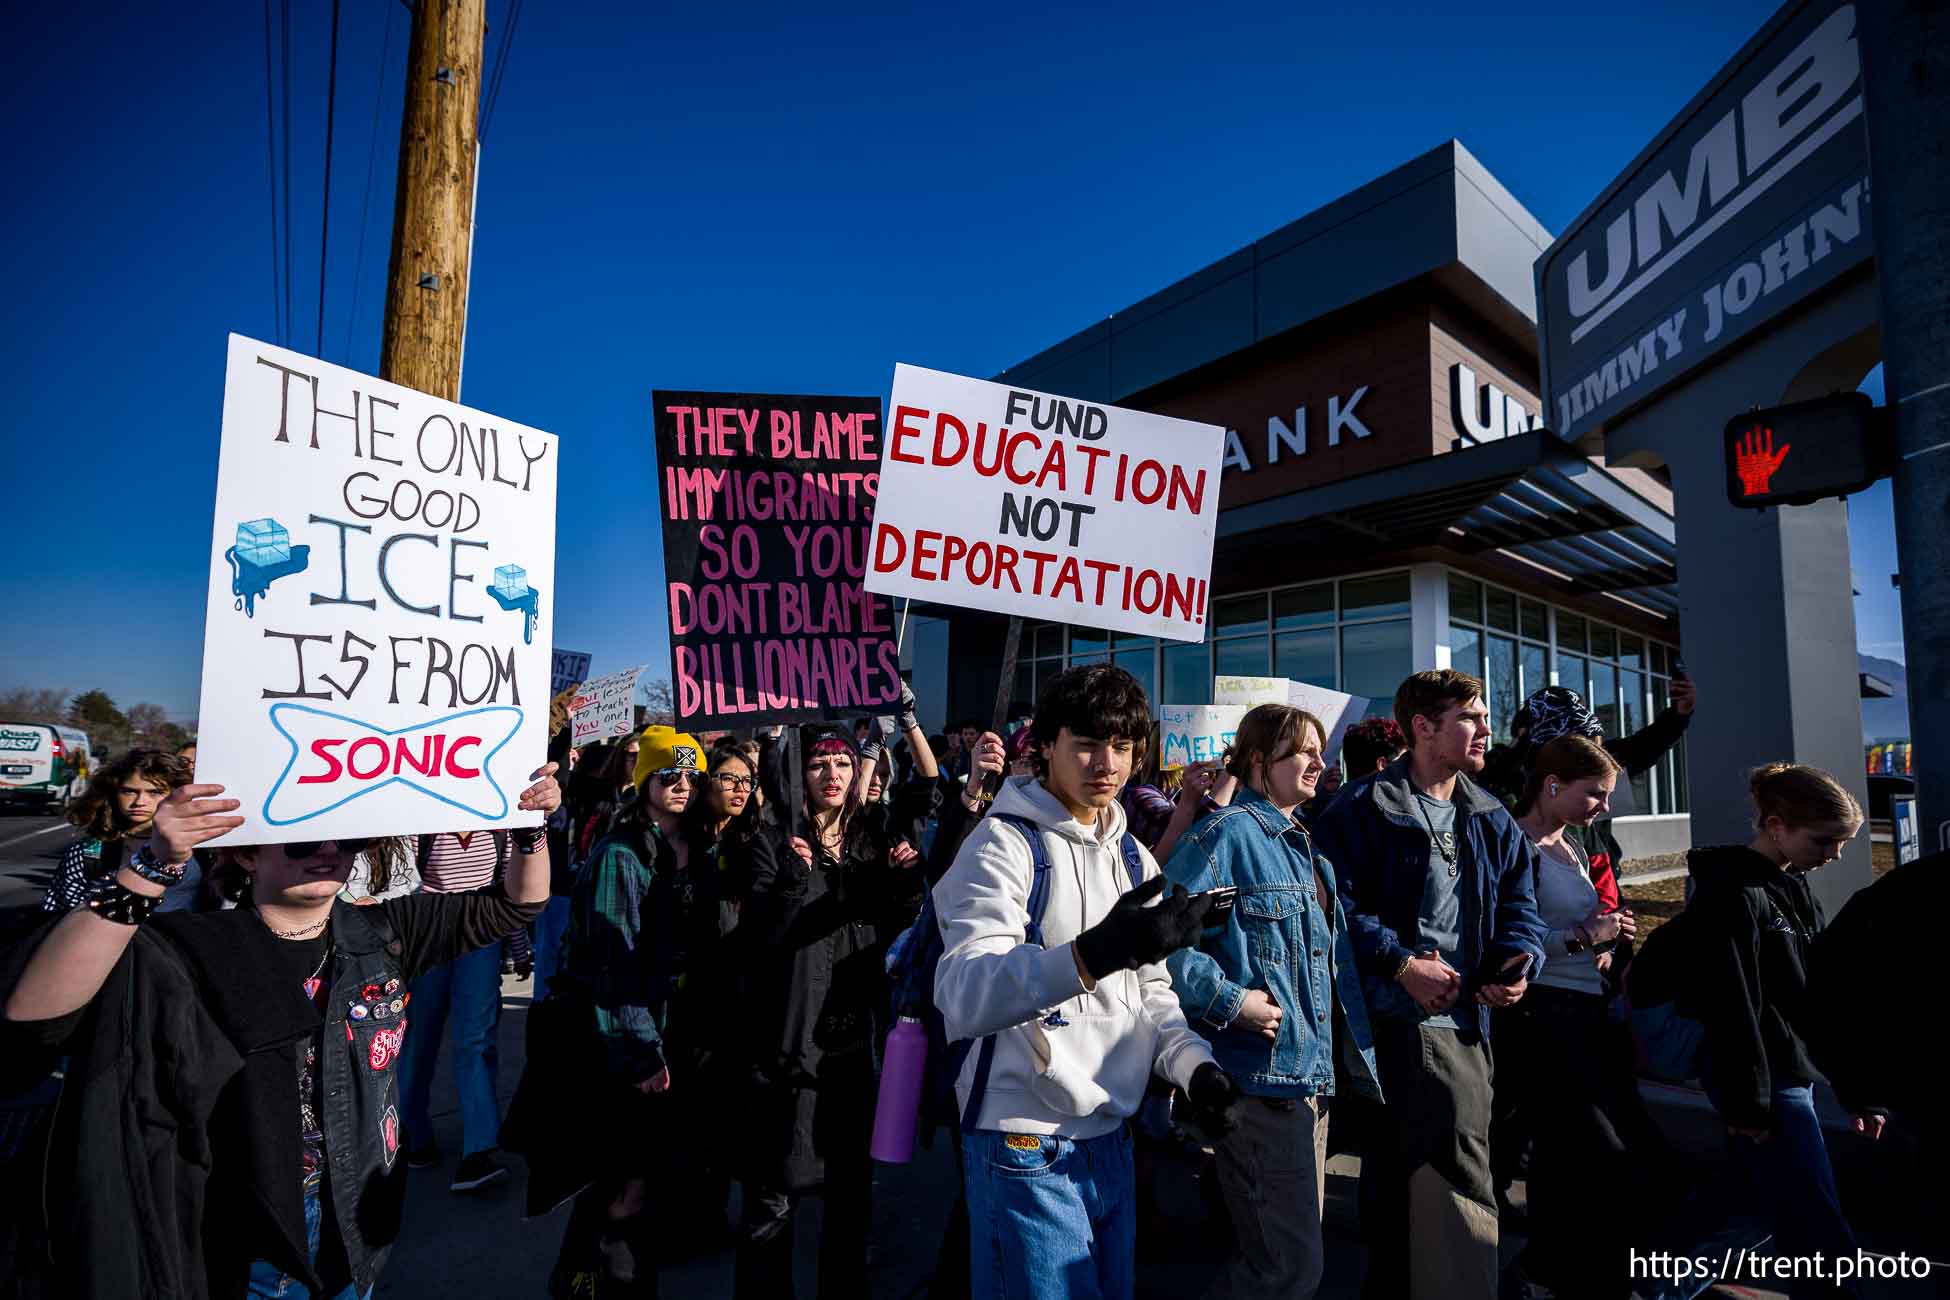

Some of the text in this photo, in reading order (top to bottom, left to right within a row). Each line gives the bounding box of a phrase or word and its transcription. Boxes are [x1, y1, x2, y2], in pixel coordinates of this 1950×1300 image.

[1567, 3, 1861, 318] UMB
[1556, 308, 1687, 437] JIMMY
[257, 356, 547, 491] THE ONLY
[666, 406, 878, 461] THEY BLAME
[1004, 390, 1108, 440] FUND
[1222, 385, 1372, 472] ANK
[667, 466, 880, 521] IMMIGRANTS
[891, 405, 1207, 515] EDUCATION
[343, 472, 481, 533] GOOD
[998, 493, 1095, 547] NOT
[308, 513, 490, 623] ICE
[700, 525, 870, 580] SO YOU
[873, 523, 1207, 624] DEPORTATION!
[778, 583, 892, 634] BLAME
[261, 629, 520, 708] IS FROM
[675, 637, 901, 717] BILLIONAIRES
[297, 734, 483, 784] SONIC
